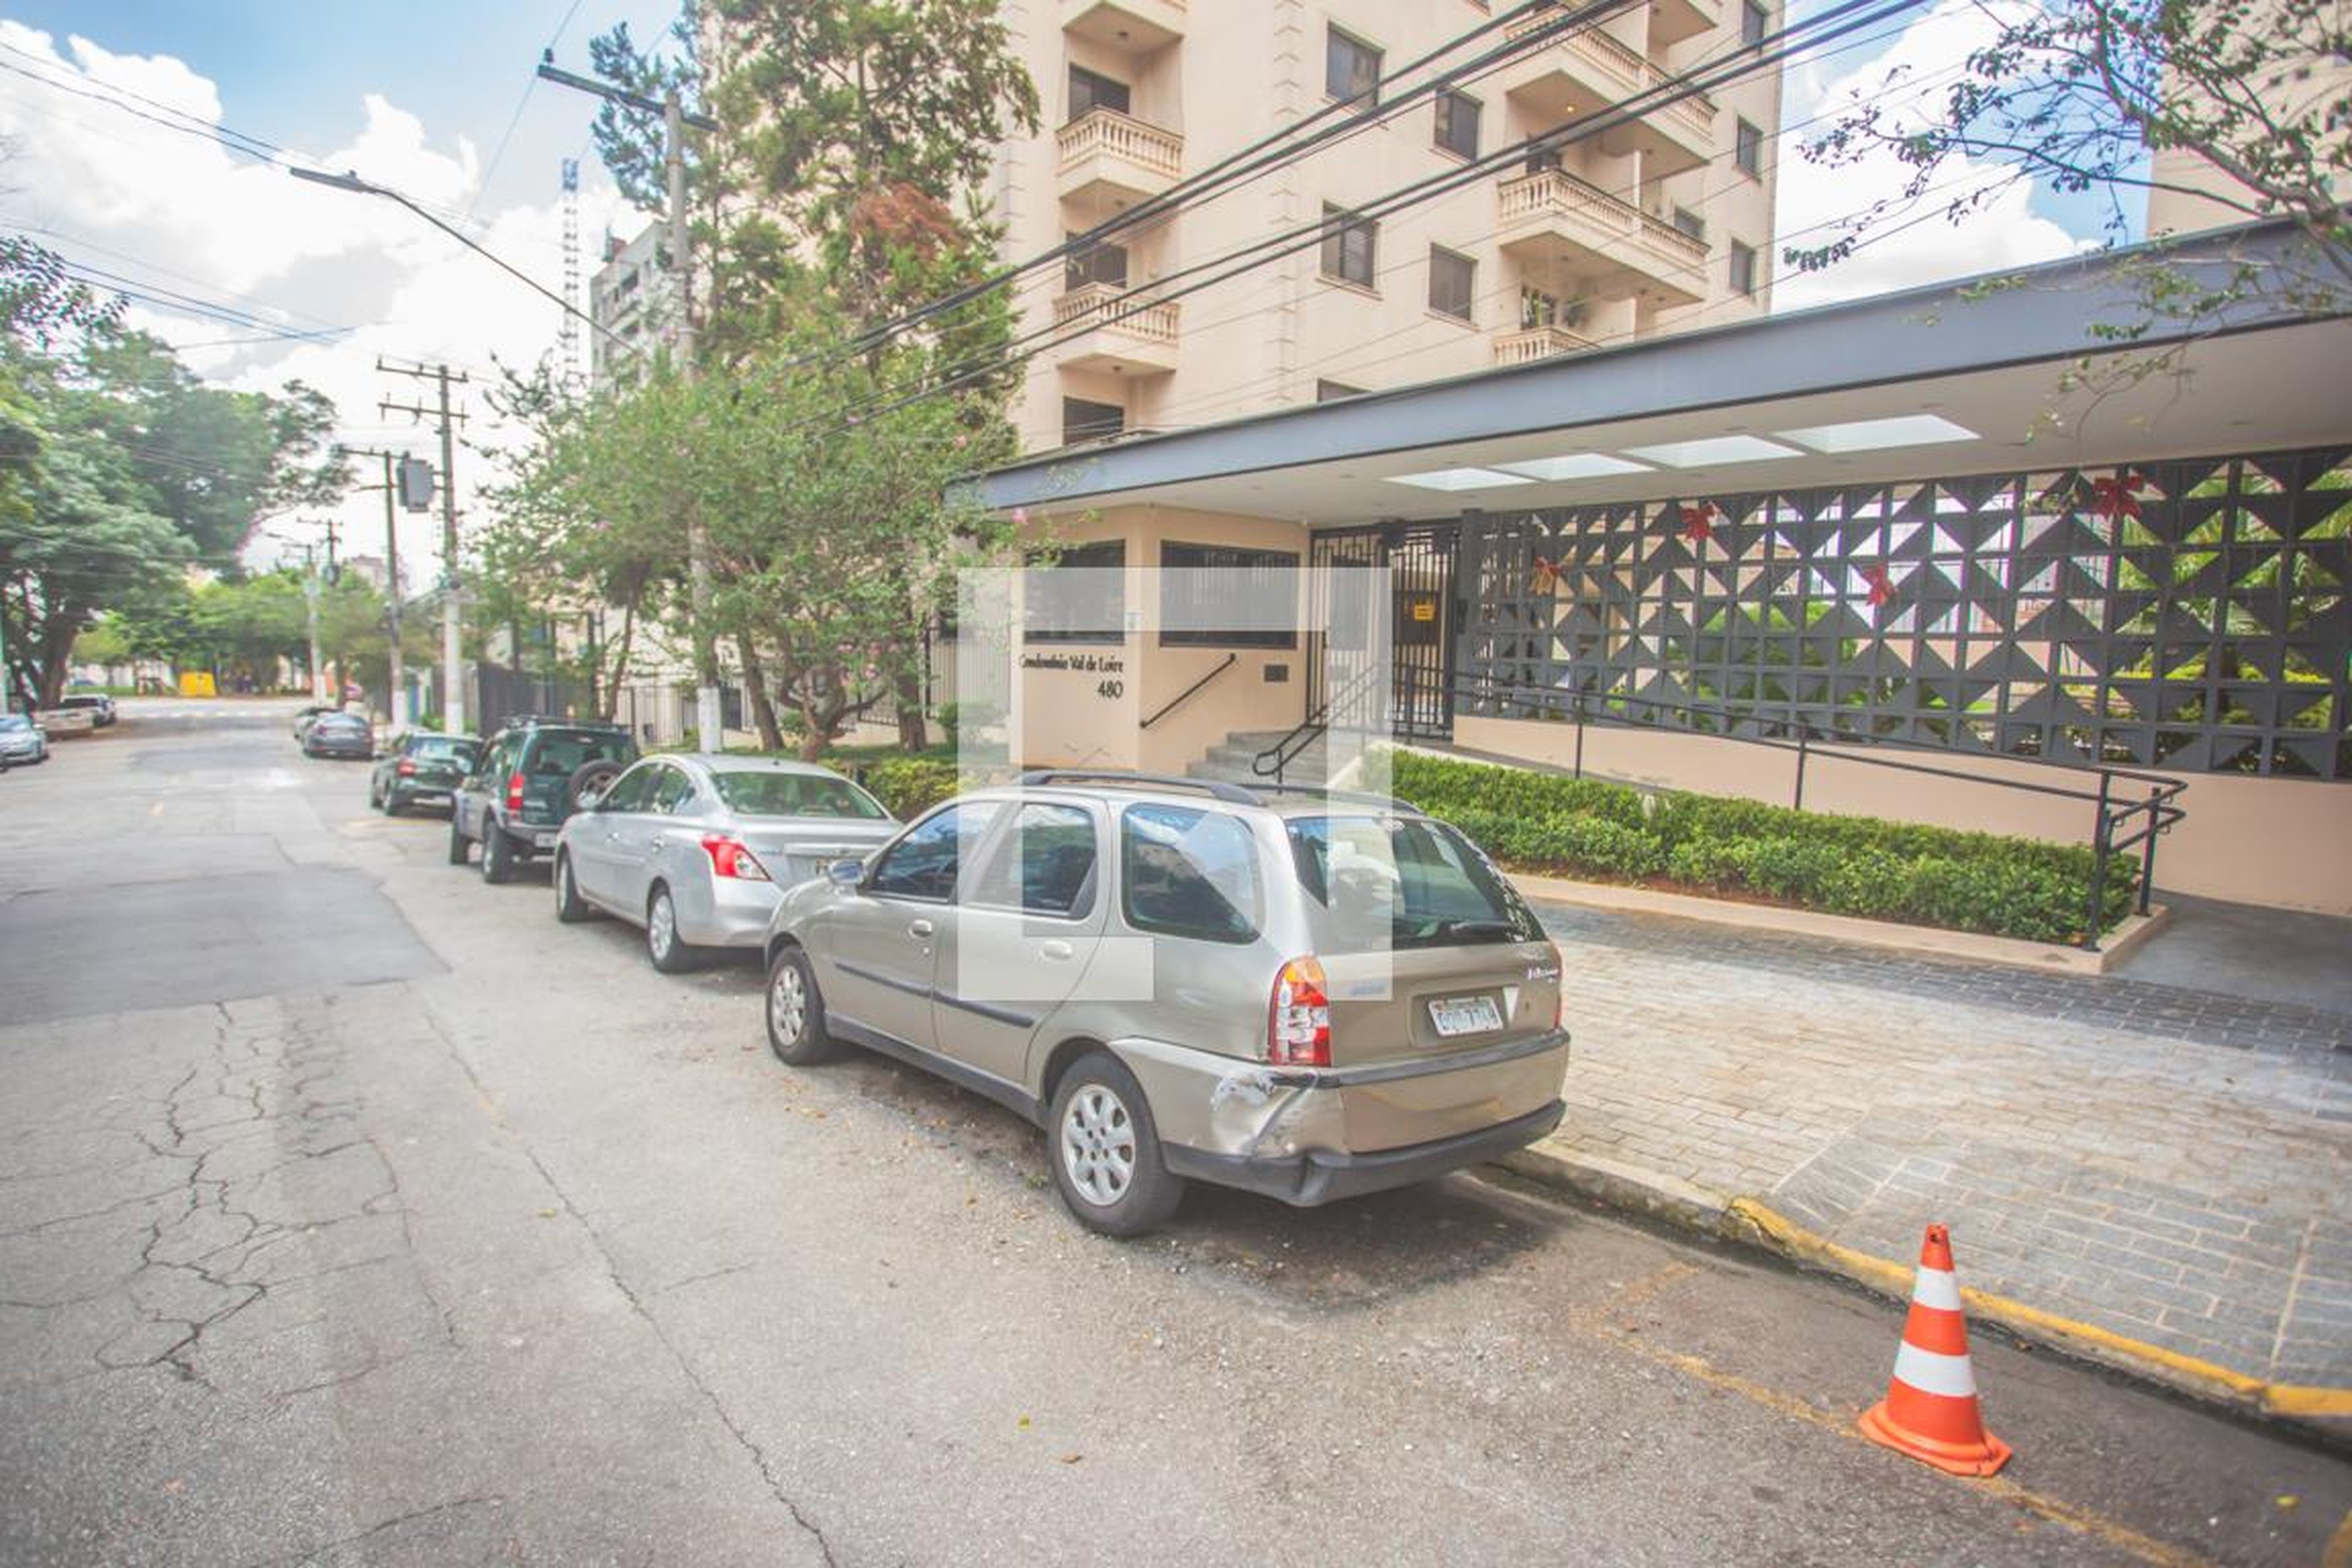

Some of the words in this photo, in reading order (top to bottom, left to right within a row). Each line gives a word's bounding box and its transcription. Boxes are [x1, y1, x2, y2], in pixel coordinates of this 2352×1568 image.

[1068, 654, 1085, 670] Val
[1086, 654, 1098, 671] de
[1098, 655, 1124, 673] Loire
[1098, 679, 1125, 699] 480
